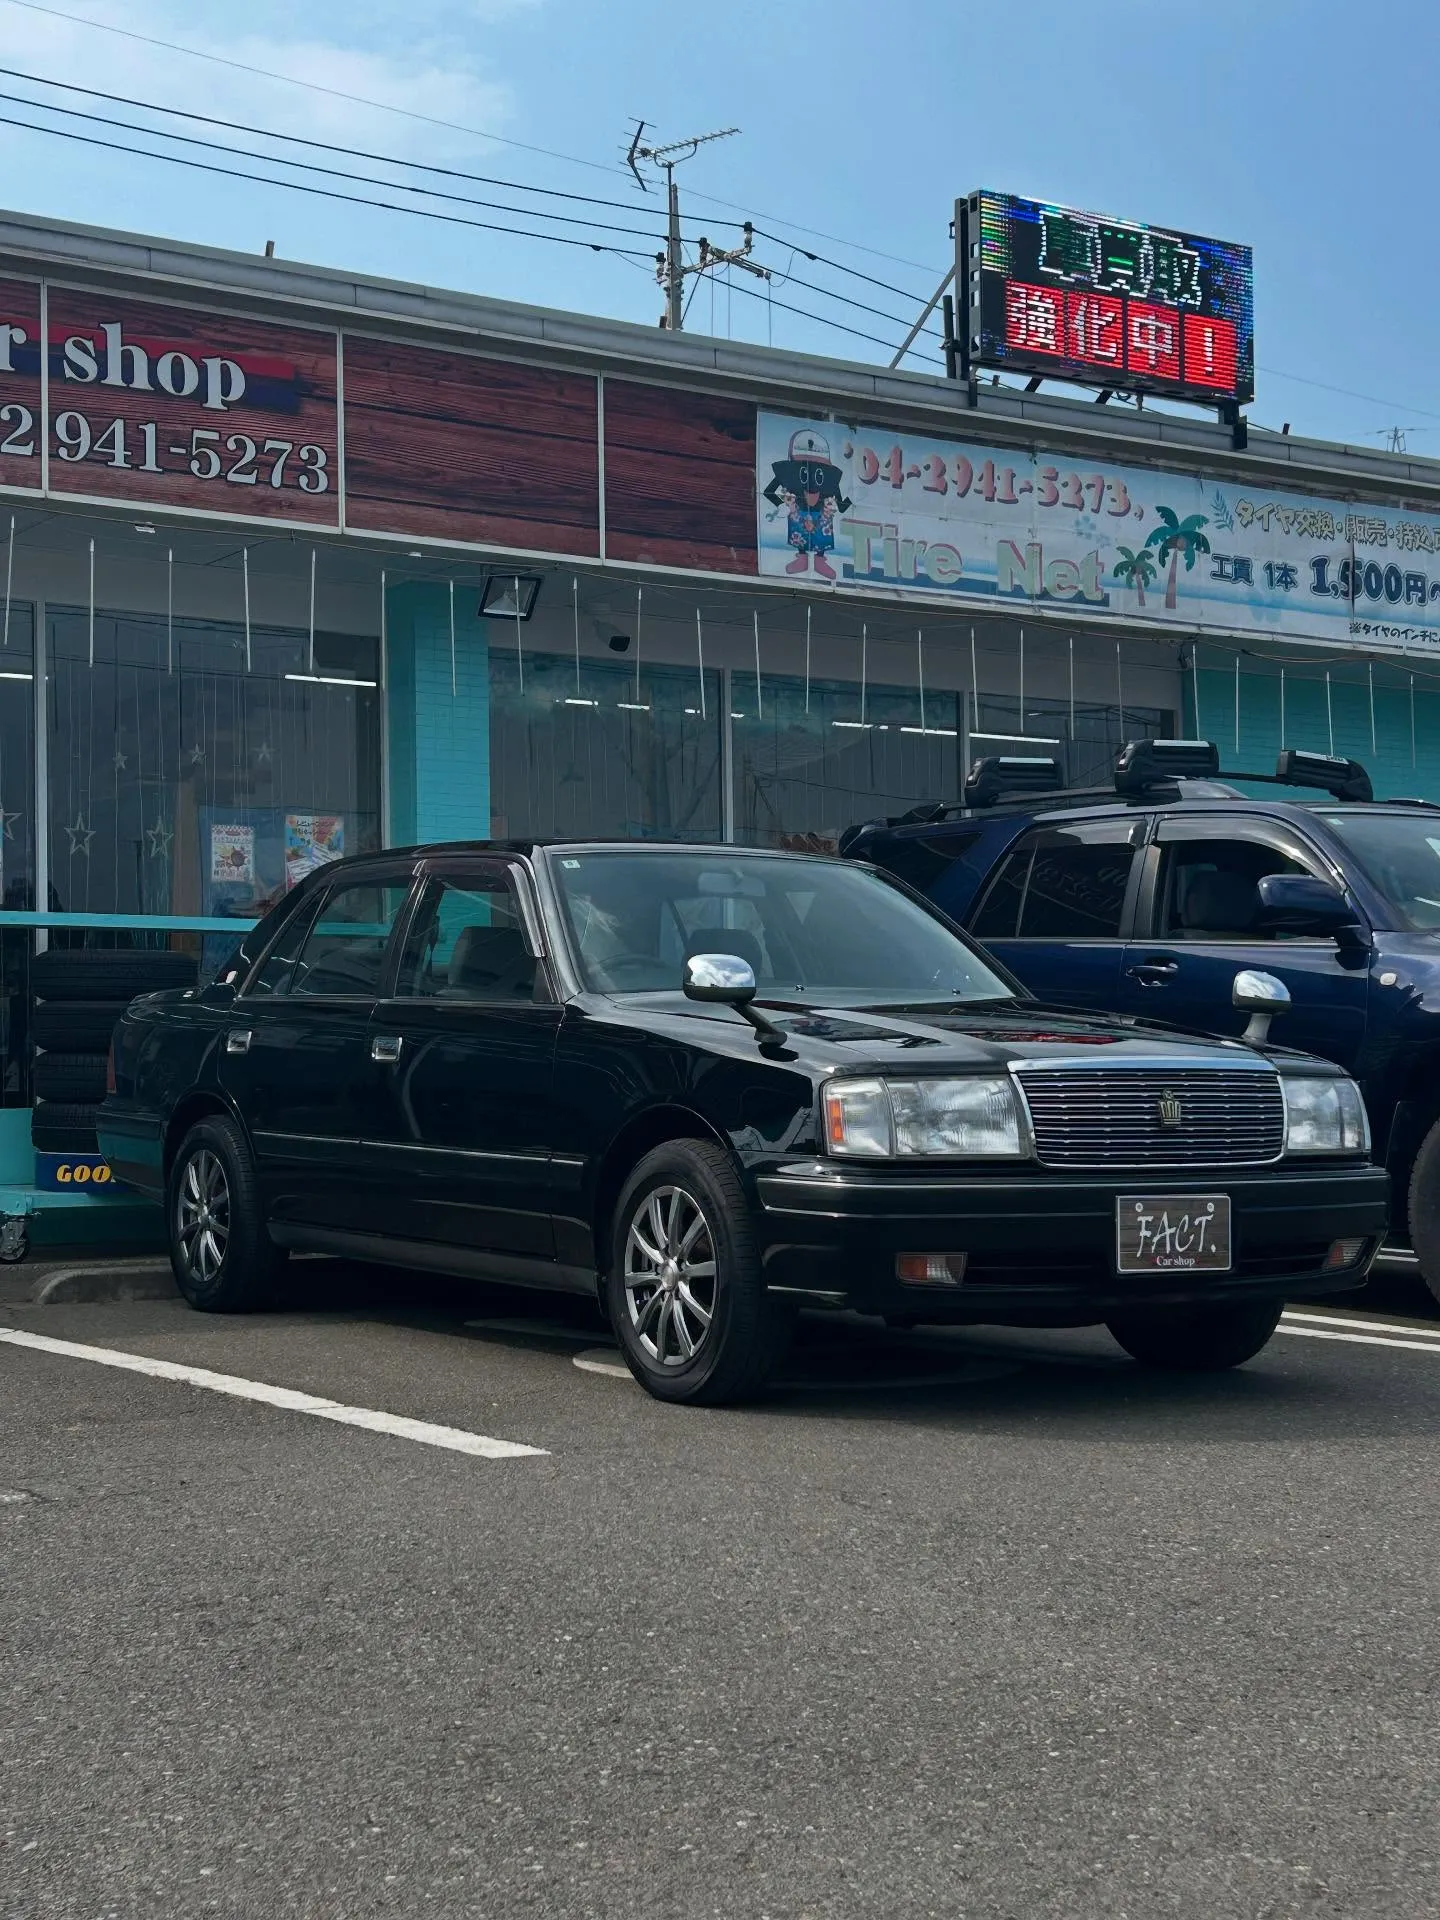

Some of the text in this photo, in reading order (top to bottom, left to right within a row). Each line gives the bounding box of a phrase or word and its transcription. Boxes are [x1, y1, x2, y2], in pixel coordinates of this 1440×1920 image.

[63, 322, 247, 410] shop
[1235, 498, 1440, 553] タイヤ交換・販売・持込
[840, 518, 1110, 600] Tire Net
[1349, 622, 1440, 643] ※タイヤのインチに
[57, 1164, 115, 1183] GOO
[1156, 1255, 1196, 1267] Car shop
